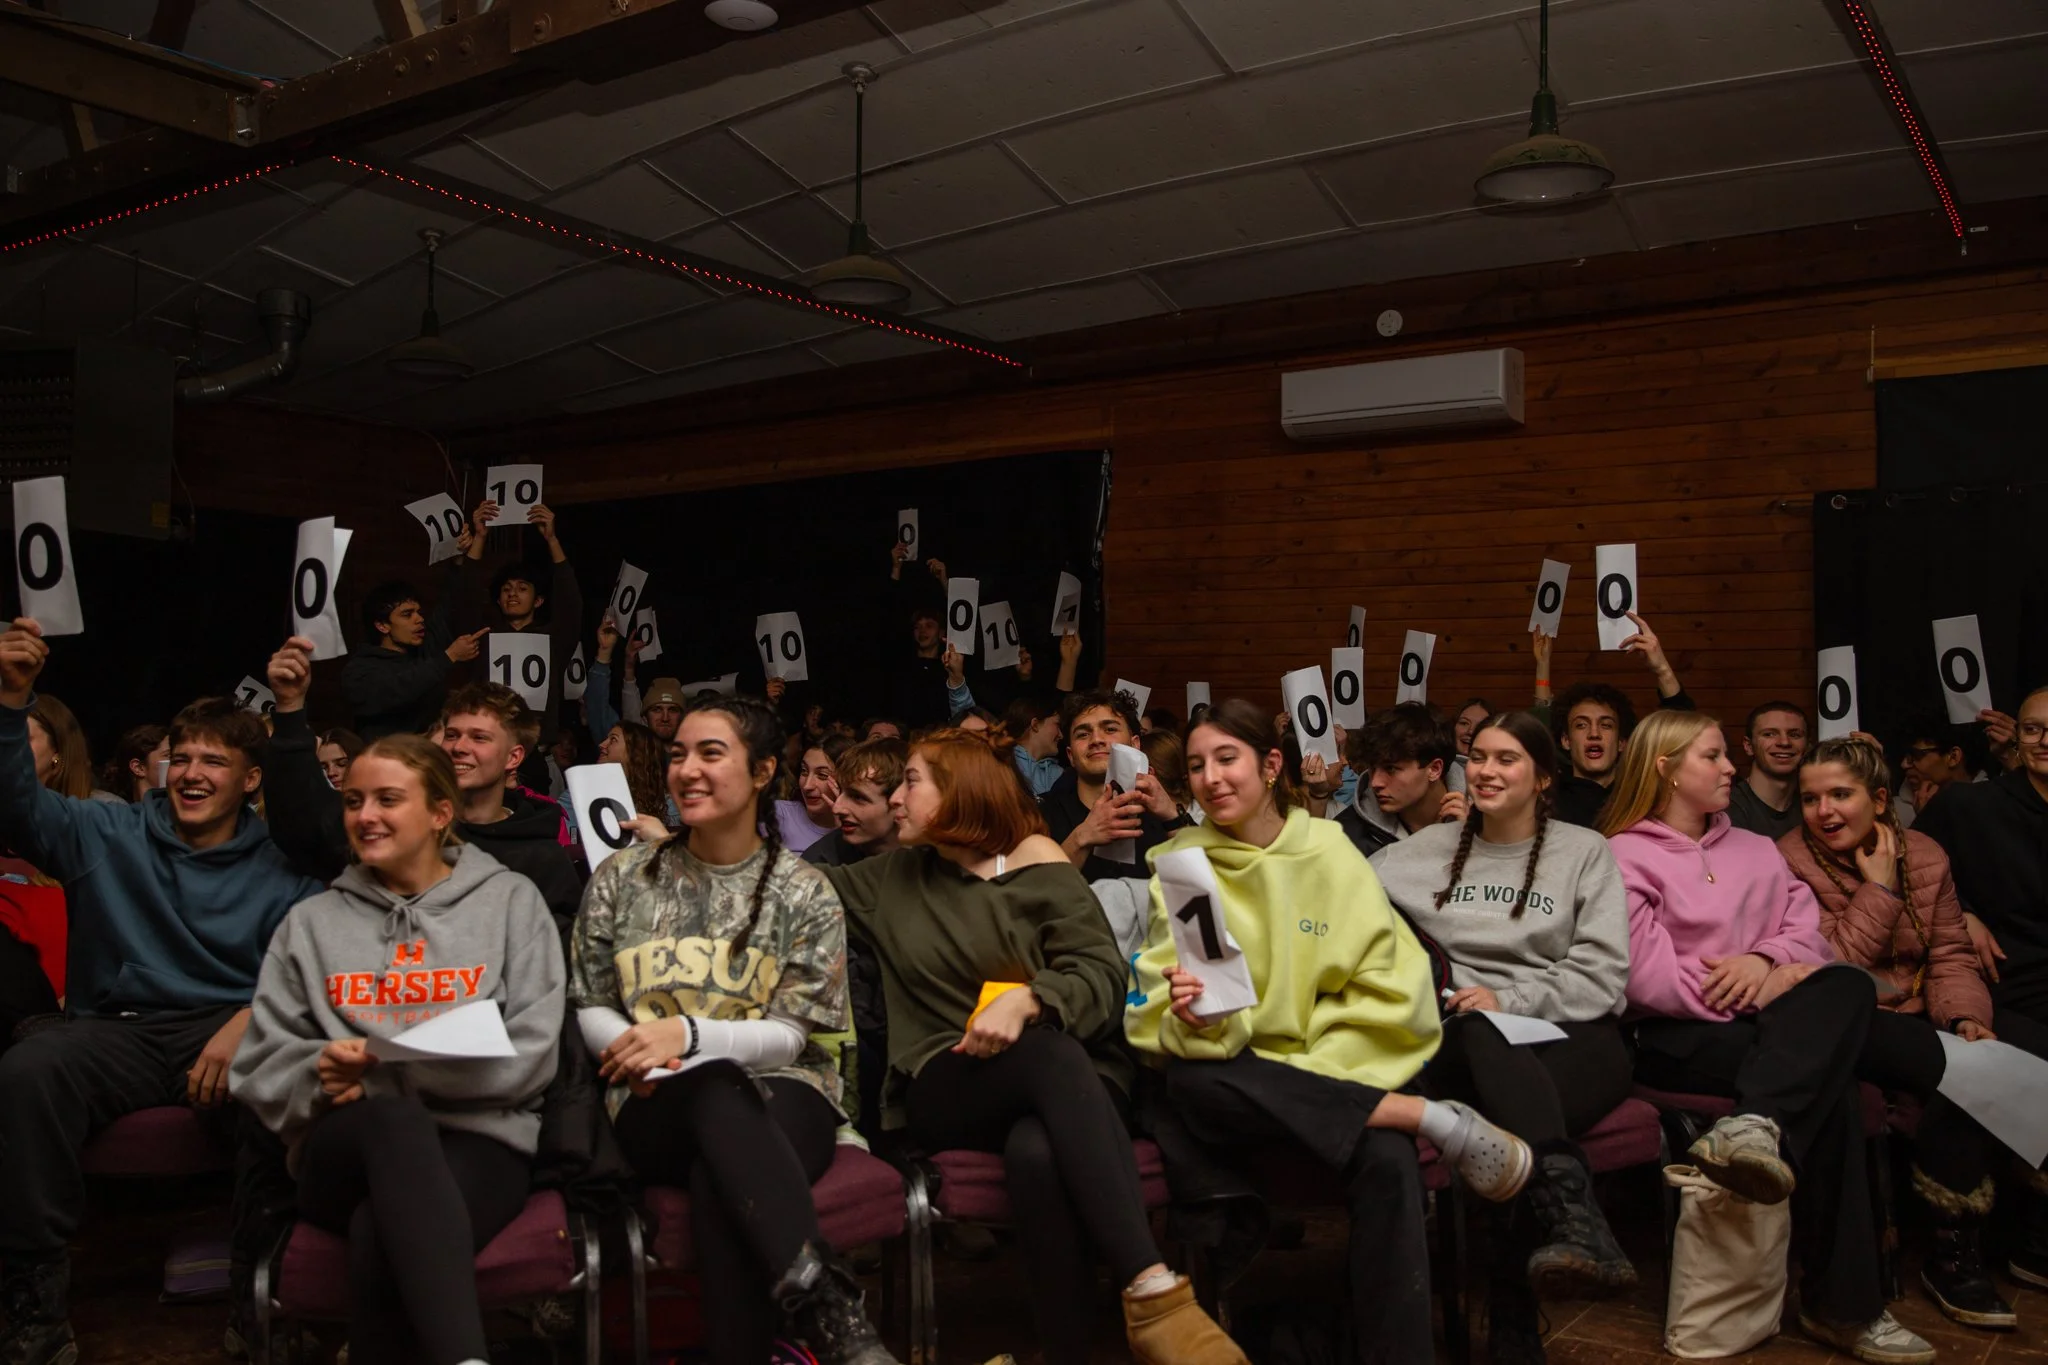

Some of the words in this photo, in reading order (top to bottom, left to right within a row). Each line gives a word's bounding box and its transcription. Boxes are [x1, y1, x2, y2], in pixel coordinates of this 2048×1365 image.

[489, 479, 538, 506] 10
[425, 509, 462, 542] 10
[900, 523, 915, 546] 0
[19, 522, 63, 590] 0
[294, 558, 327, 619] 0
[1537, 581, 1561, 614] 0
[1598, 573, 1632, 619] 0
[950, 599, 973, 631] 0
[759, 631, 802, 663] 10
[985, 618, 1019, 650] 10
[493, 654, 546, 688] 10
[567, 658, 586, 684] 0
[1401, 652, 1424, 686] 0
[1940, 647, 1980, 693] 0
[1334, 670, 1359, 705] 0
[1818, 675, 1851, 720] 0
[1298, 695, 1328, 738] 0
[589, 797, 635, 850] 0
[1434, 885, 1476, 904] HE
[1176, 894, 1223, 960] 1
[325, 964, 487, 1007] HERSEY
[614, 936, 779, 1005] JESUS
